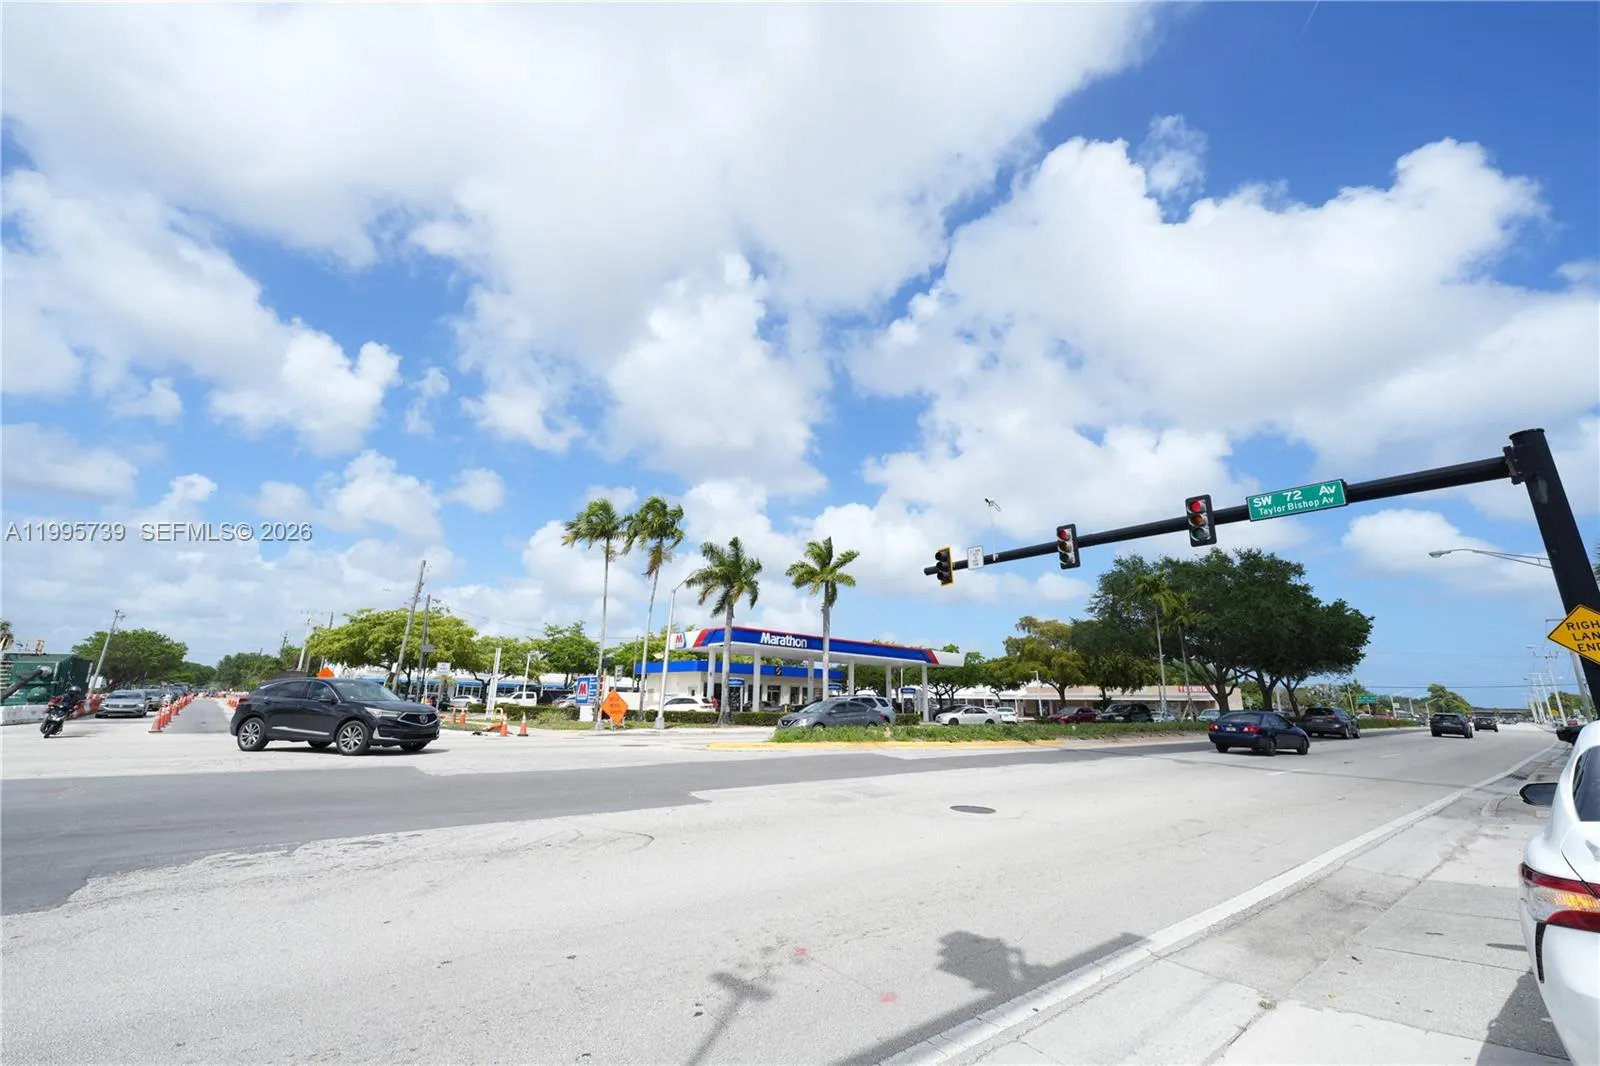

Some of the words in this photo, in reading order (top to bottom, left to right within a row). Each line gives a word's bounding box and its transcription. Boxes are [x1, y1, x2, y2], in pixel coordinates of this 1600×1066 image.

[1253, 496, 1272, 507] SW
[1283, 490, 1303, 501] 72
[1319, 485, 1336, 496] Av
[1259, 506, 1286, 516] Taylor
[1288, 499, 1320, 510] Bishop
[1322, 497, 1334, 505] Av
[760, 632, 808, 648] Marathon
